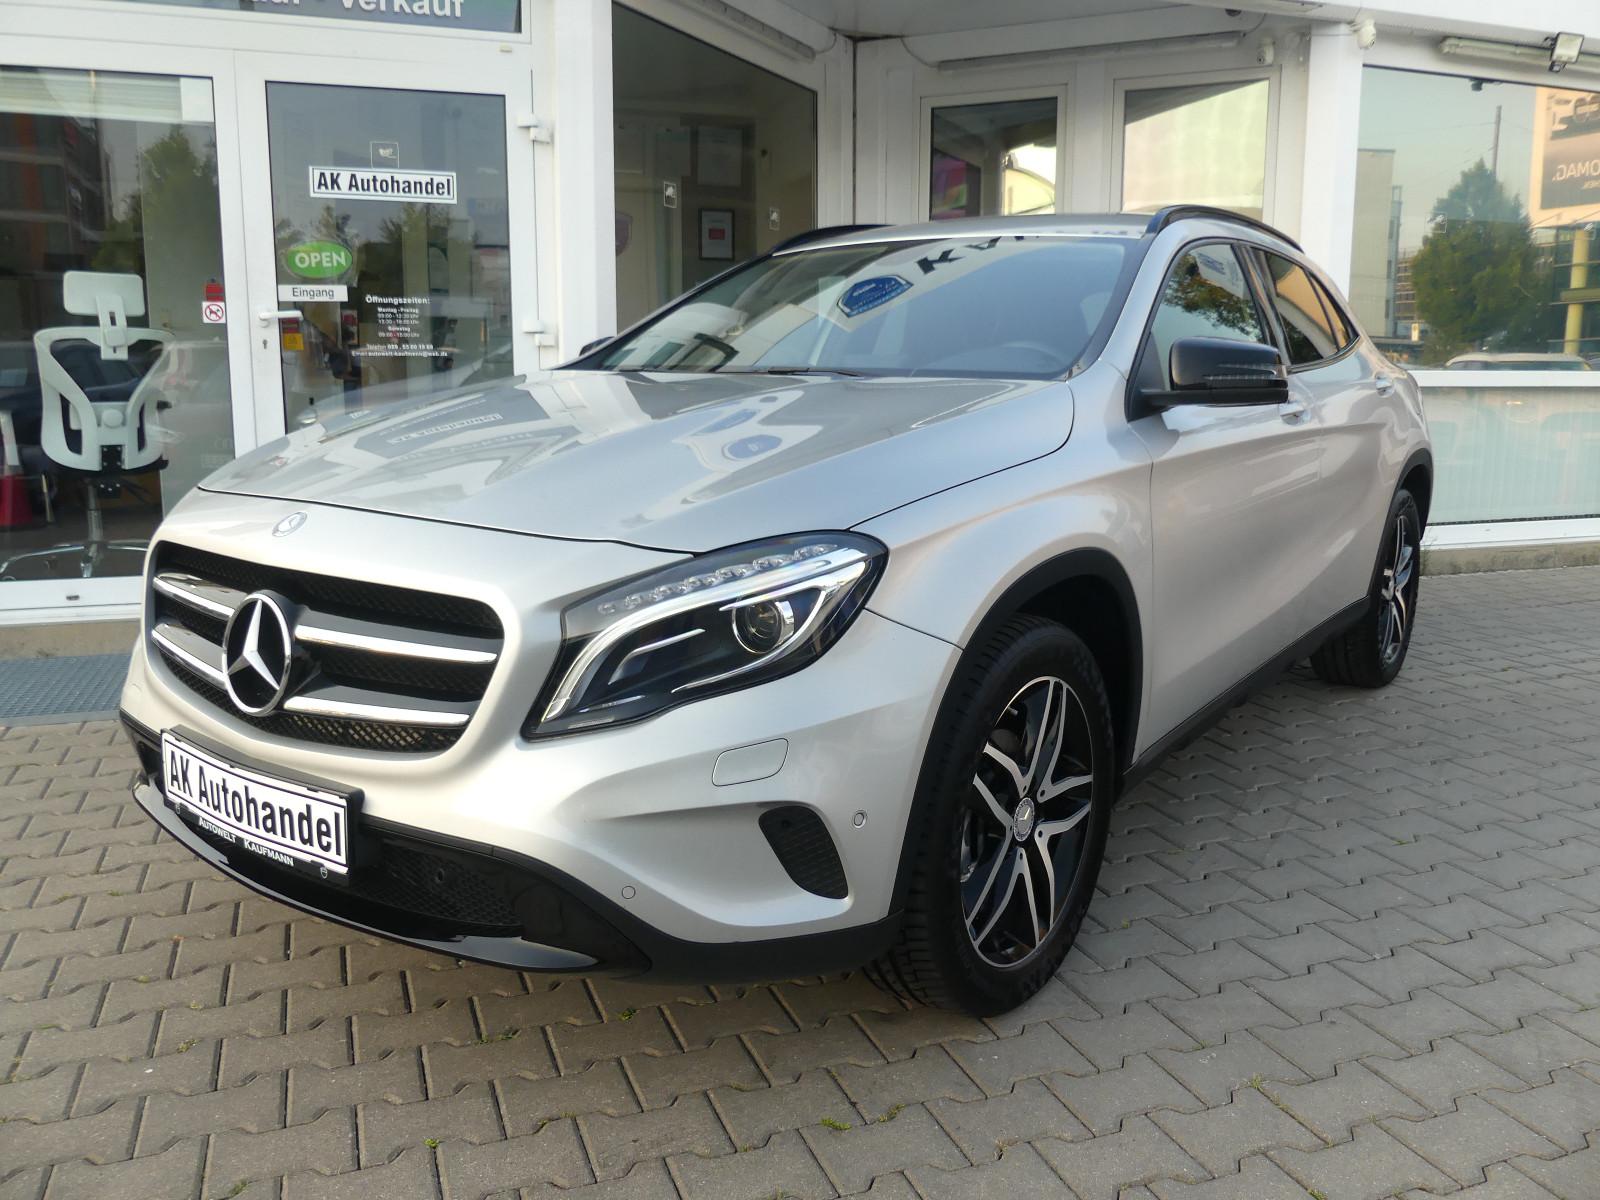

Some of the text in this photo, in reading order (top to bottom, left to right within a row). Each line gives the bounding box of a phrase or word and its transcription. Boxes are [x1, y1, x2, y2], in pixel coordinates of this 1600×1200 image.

[317, 172, 452, 196] AK Autohandel
[294, 251, 346, 268] OPEN
[292, 287, 335, 299] Eingang
[170, 750, 342, 856] AK Autohandel
[199, 818, 295, 867] AUTOWELT KAUFMANN
